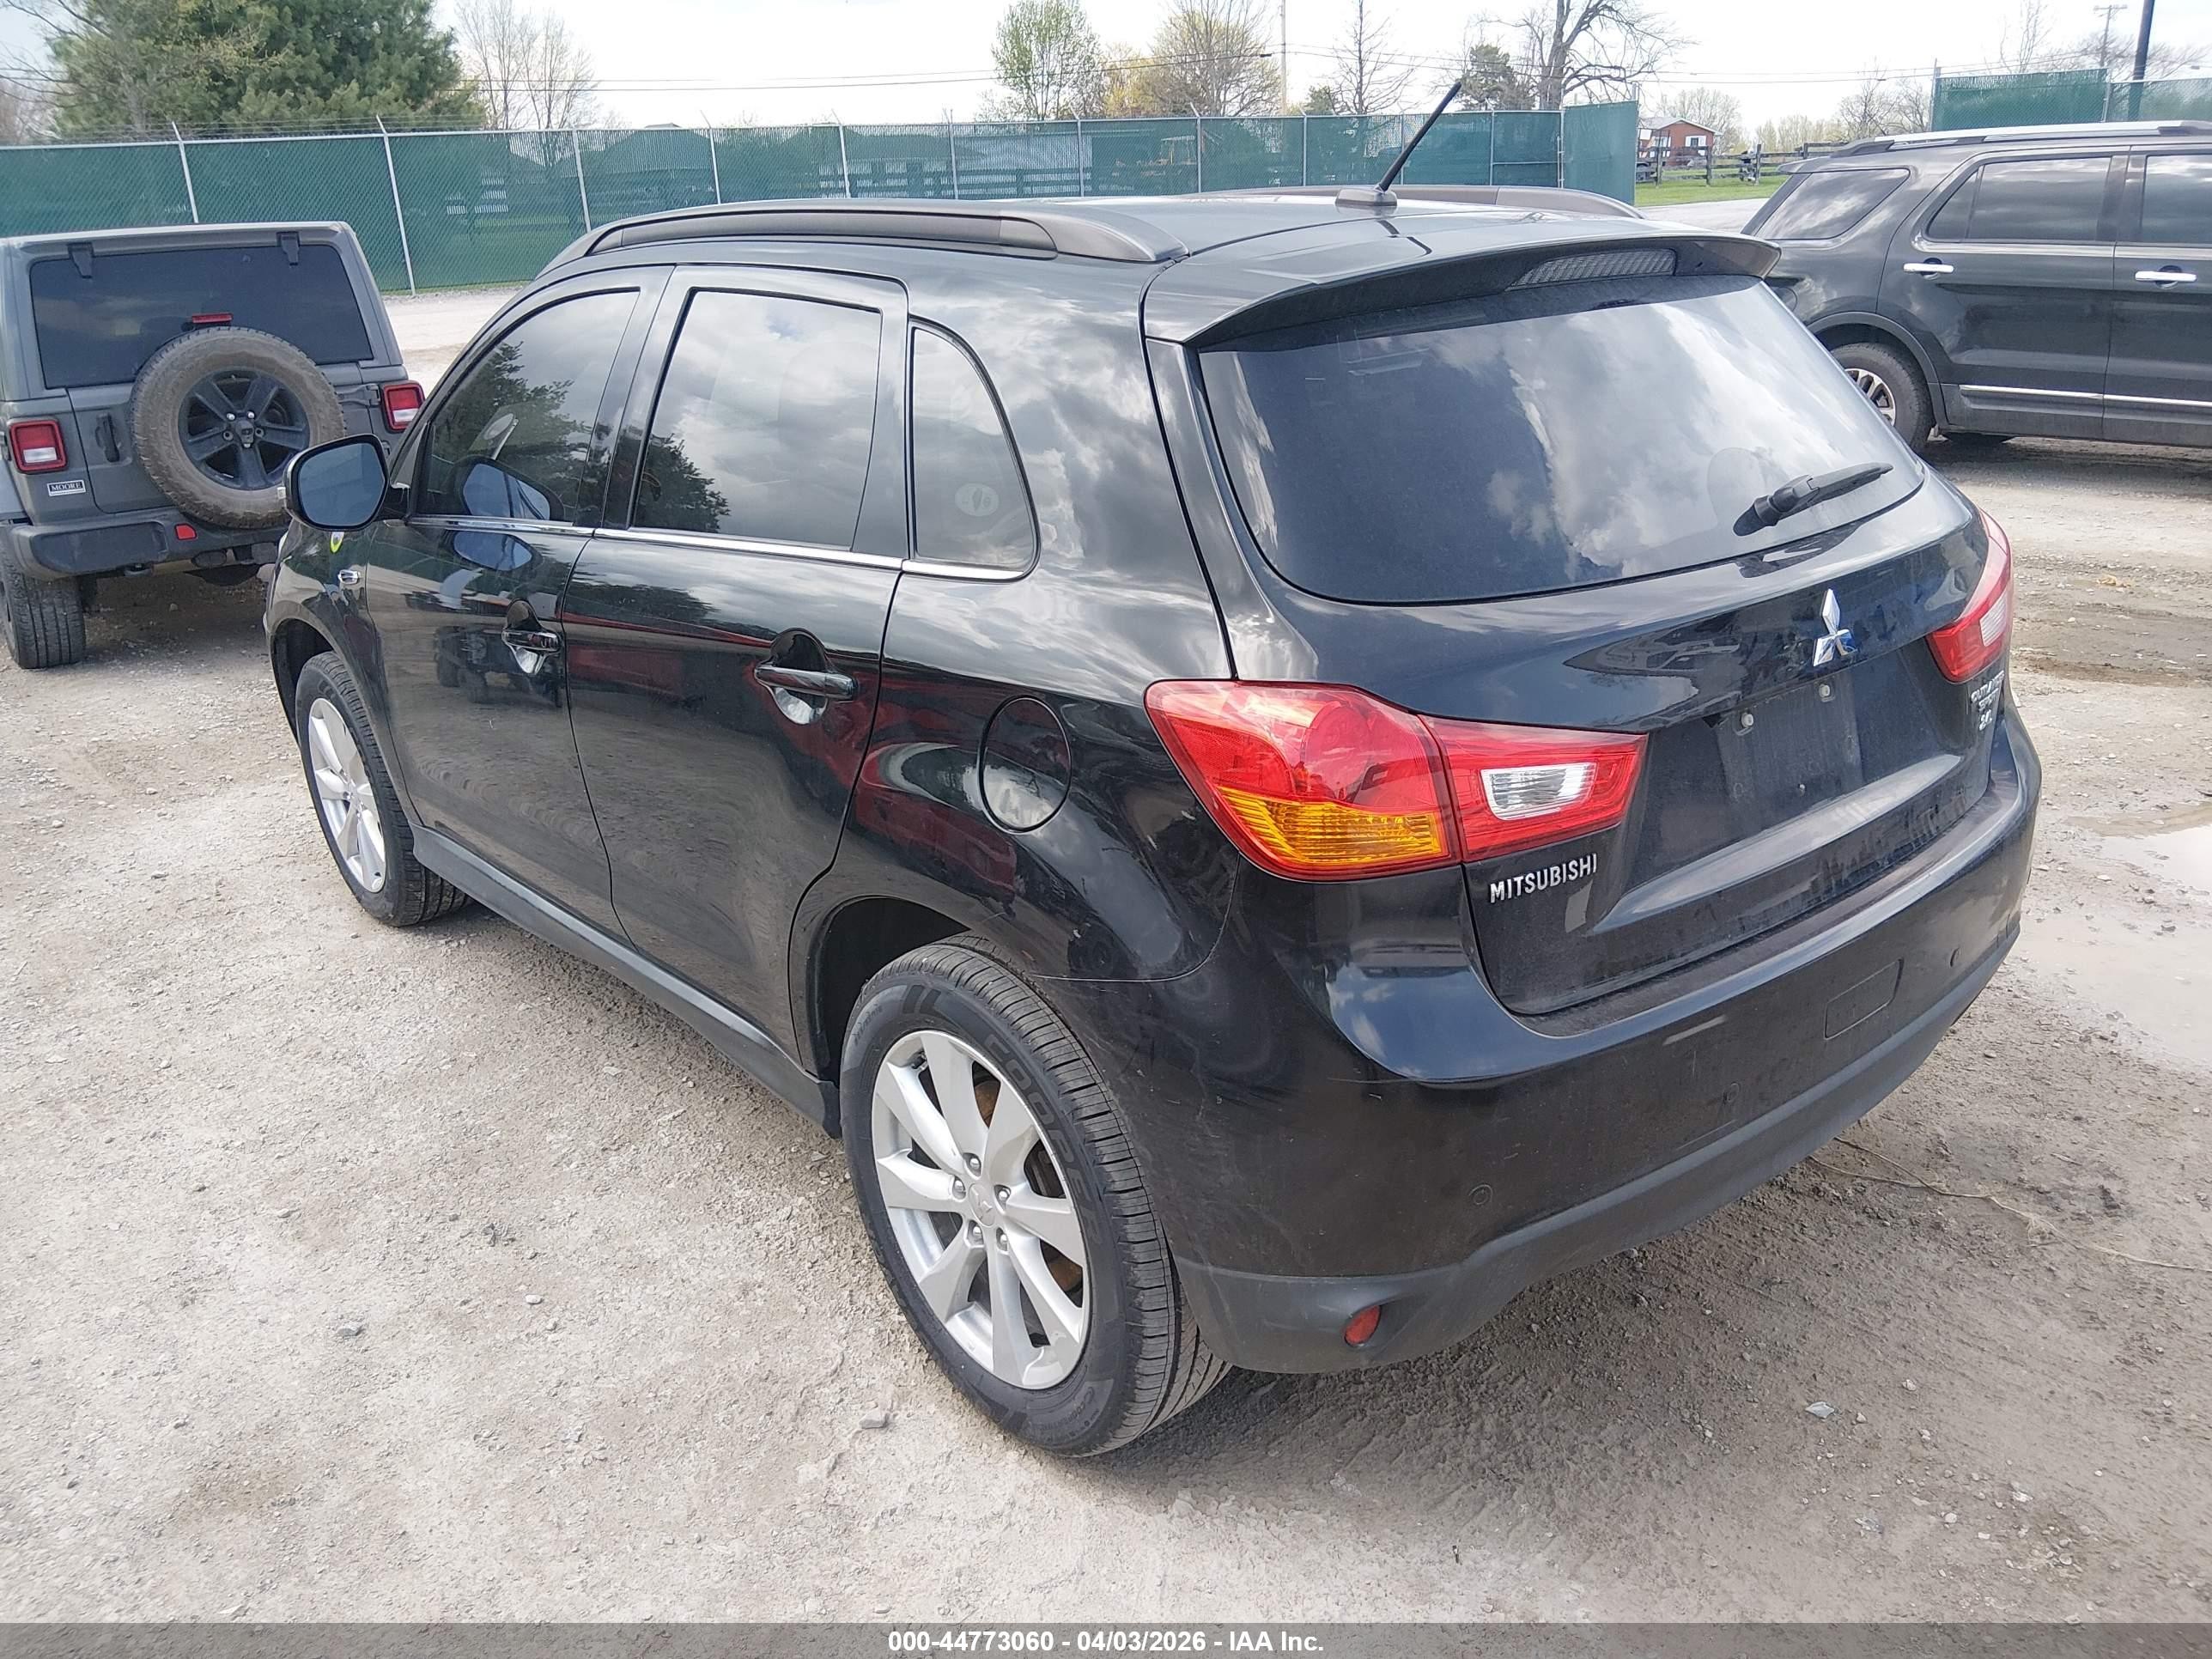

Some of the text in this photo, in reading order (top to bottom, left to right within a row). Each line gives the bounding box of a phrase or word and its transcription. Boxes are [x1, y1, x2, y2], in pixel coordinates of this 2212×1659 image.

[51, 482, 82, 490] MOORE
[1971, 669, 2005, 703] OUTLER
[1489, 853, 1597, 903] MITSUBISHI
[984, 1033, 1103, 1244] COOPER
